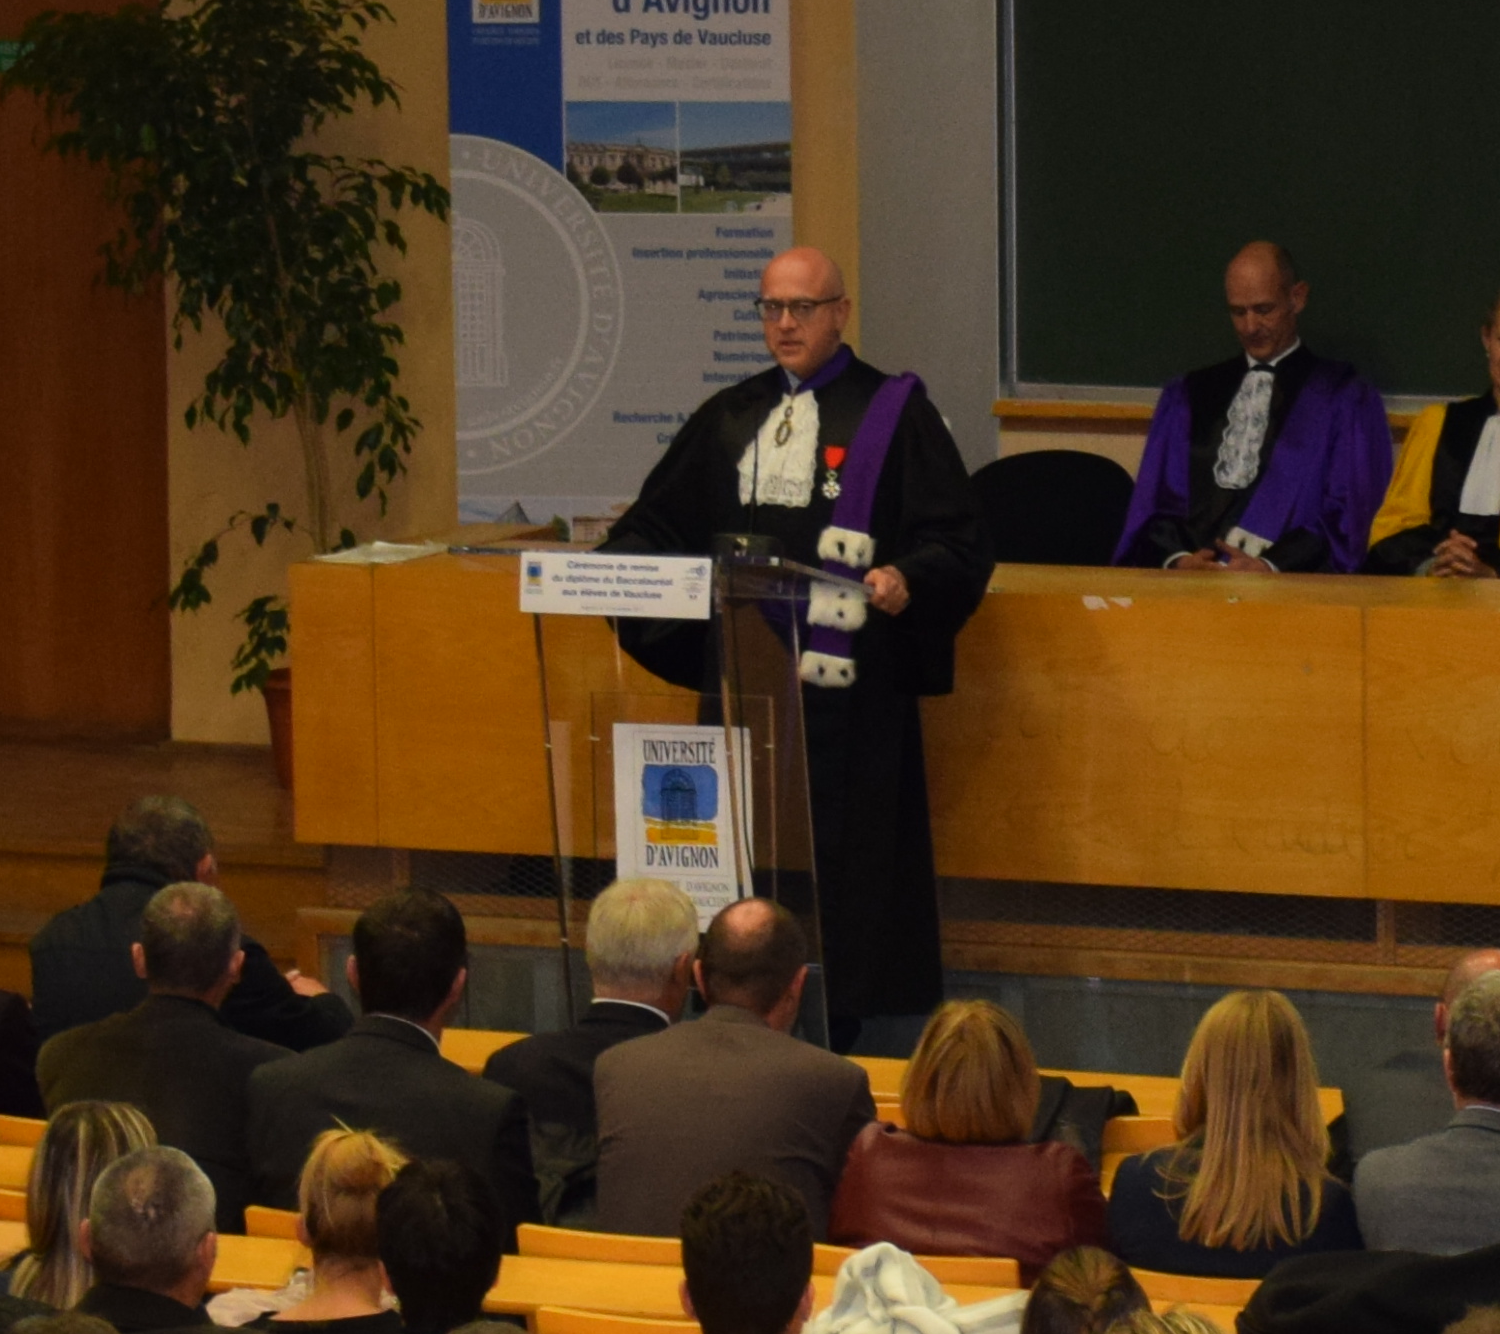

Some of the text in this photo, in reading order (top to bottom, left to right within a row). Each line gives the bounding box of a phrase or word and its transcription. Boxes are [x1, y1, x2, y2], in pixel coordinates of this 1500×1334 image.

[574, 28, 772, 48] et des Pays de Vaucluse
[715, 226, 775, 238] Formation
[686, 247, 775, 260] professionnelle
[612, 410, 673, 423] Recherche
[642, 737, 717, 765] UNIVERSITÉ
[646, 845, 720, 868] D'AVIGNON
